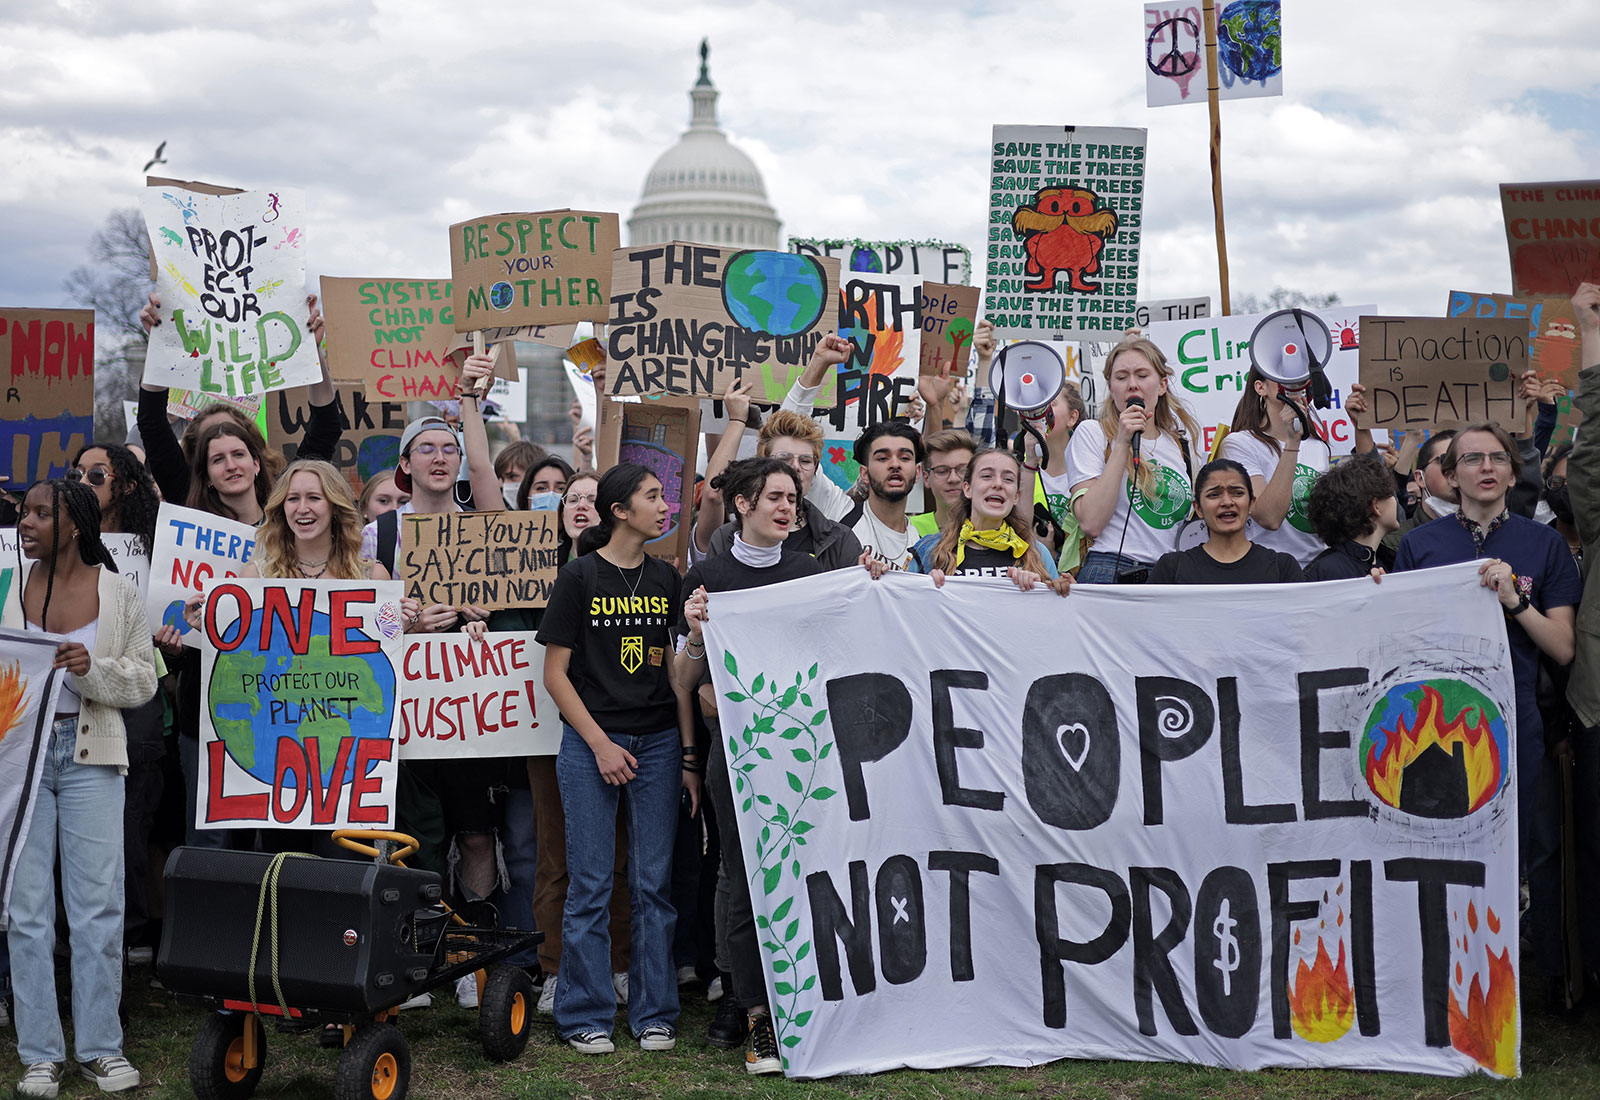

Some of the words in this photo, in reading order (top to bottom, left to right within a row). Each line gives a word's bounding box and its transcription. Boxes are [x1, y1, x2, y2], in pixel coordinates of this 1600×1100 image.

[994, 142, 1042, 158] SAVE
[1046, 143, 1082, 159] THE
[1085, 144, 1145, 160] TREES
[993, 160, 1041, 174] SAVE
[1045, 160, 1081, 175] THE
[1085, 161, 1143, 177] TREES
[991, 176, 1040, 190] SAVE
[1084, 179, 1143, 194] TREES
[1506, 189, 1544, 202] THE
[1097, 196, 1142, 211] REES
[463, 216, 600, 264] RESPECT
[203, 263, 254, 293] ECT
[504, 256, 554, 275] YOUR
[629, 245, 721, 288] THE
[988, 261, 1024, 276] SAV
[986, 279, 1023, 294] SAV
[200, 293, 261, 323] OUR
[369, 306, 455, 327] CHANG
[609, 288, 663, 326] IS
[921, 293, 958, 315] ople
[985, 296, 1033, 311] SAVE
[1037, 297, 1074, 312] THE
[1077, 298, 1136, 313] TREES
[375, 326, 425, 345] NOT
[985, 313, 1032, 329] SAVE
[1036, 315, 1073, 330] THE
[1077, 316, 1135, 331] TREES
[608, 319, 771, 364] CHANGING
[1369, 320, 1525, 361] Inaction
[611, 358, 753, 396] AREN'T
[1373, 380, 1515, 424] DEATH
[169, 519, 256, 563] THERE
[405, 513, 474, 547] THE
[171, 557, 214, 592] NO
[407, 579, 498, 606] ACTION
[590, 596, 669, 615] SUNRISE
[204, 583, 381, 656] ONE
[403, 638, 530, 683] CLIMATE
[242, 671, 322, 693] PROTECT
[325, 671, 360, 690] OUR
[270, 696, 358, 725] PLANET
[398, 680, 540, 746] JUSTICE!
[826, 667, 1370, 831] PEOPLE
[205, 736, 395, 825] LOVE
[806, 850, 1000, 1002] NOT
[1034, 857, 1487, 1048] PROFIT
